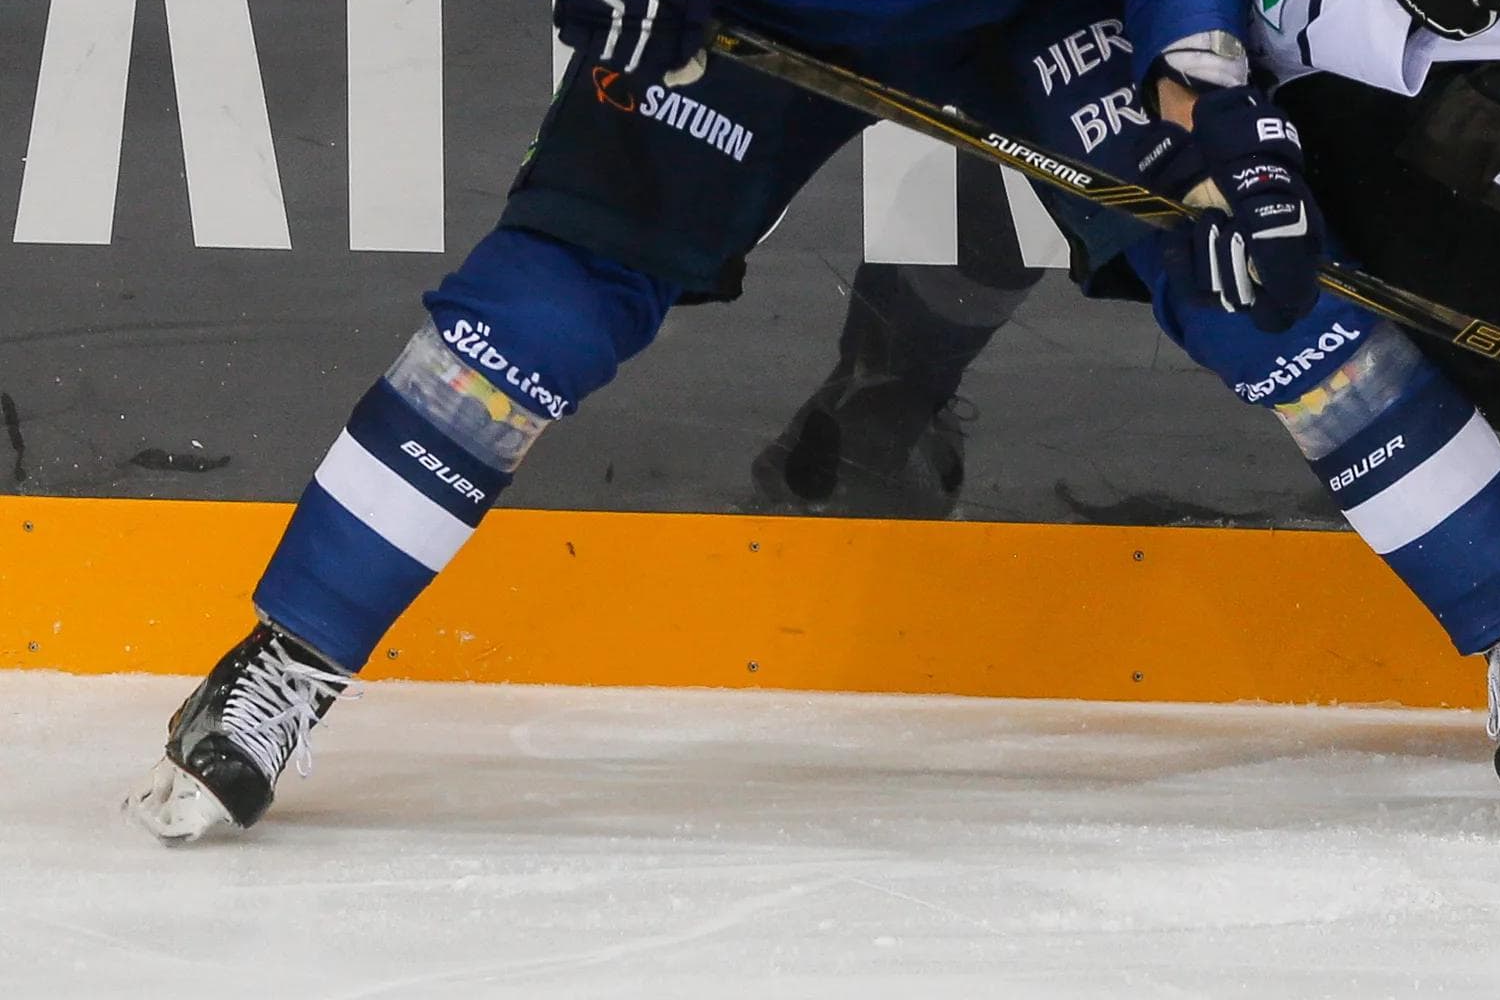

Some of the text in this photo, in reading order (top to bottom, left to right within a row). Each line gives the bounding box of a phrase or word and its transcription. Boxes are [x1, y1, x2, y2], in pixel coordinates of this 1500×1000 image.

[639, 84, 754, 163] SATURN
[981, 132, 1094, 190] SUPREME
[400, 439, 486, 504] BAUER
[1329, 433, 1406, 492] BAUER
